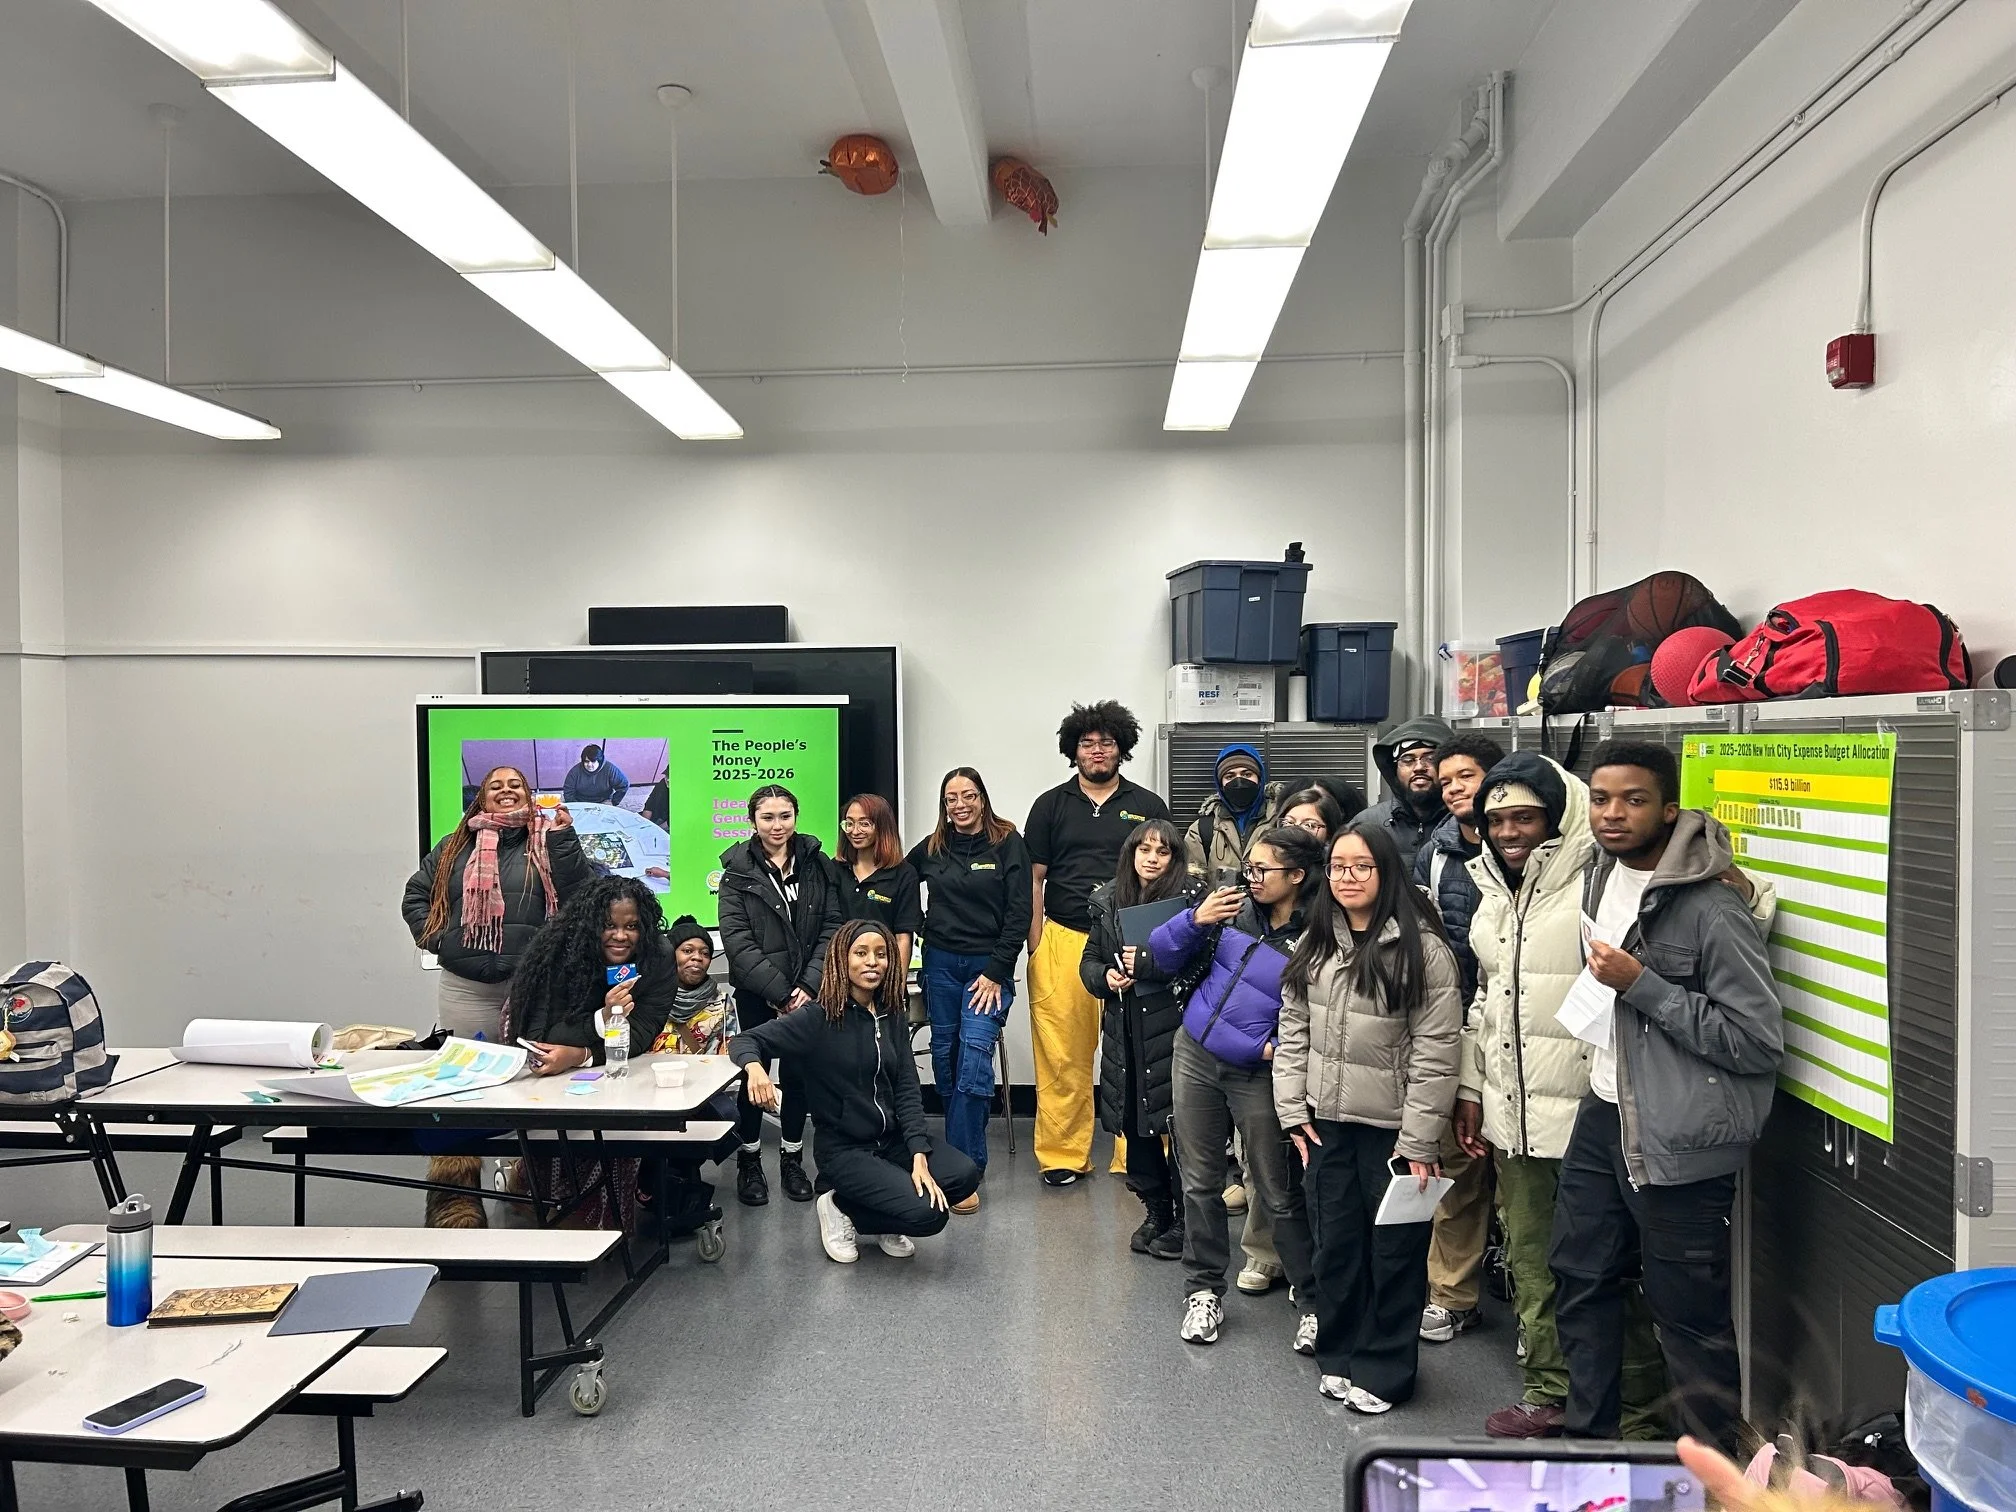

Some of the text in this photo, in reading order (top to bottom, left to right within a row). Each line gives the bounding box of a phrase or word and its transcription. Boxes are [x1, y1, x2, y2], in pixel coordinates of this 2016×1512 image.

[712, 739, 807, 753] The People's
[1720, 743, 1752, 756] 2025-2026
[1753, 744, 1763, 757] New
[1764, 744, 1776, 757] York
[1777, 744, 1791, 760] City
[1794, 744, 1823, 760] Expense
[1825, 744, 1850, 761] Budget
[1852, 745, 1890, 760] Allocation
[712, 755, 761, 767] Money
[712, 768, 794, 780] 2025-2026
[1769, 778, 1811, 792] $115.9 billion
[713, 828, 752, 838] Sessi
